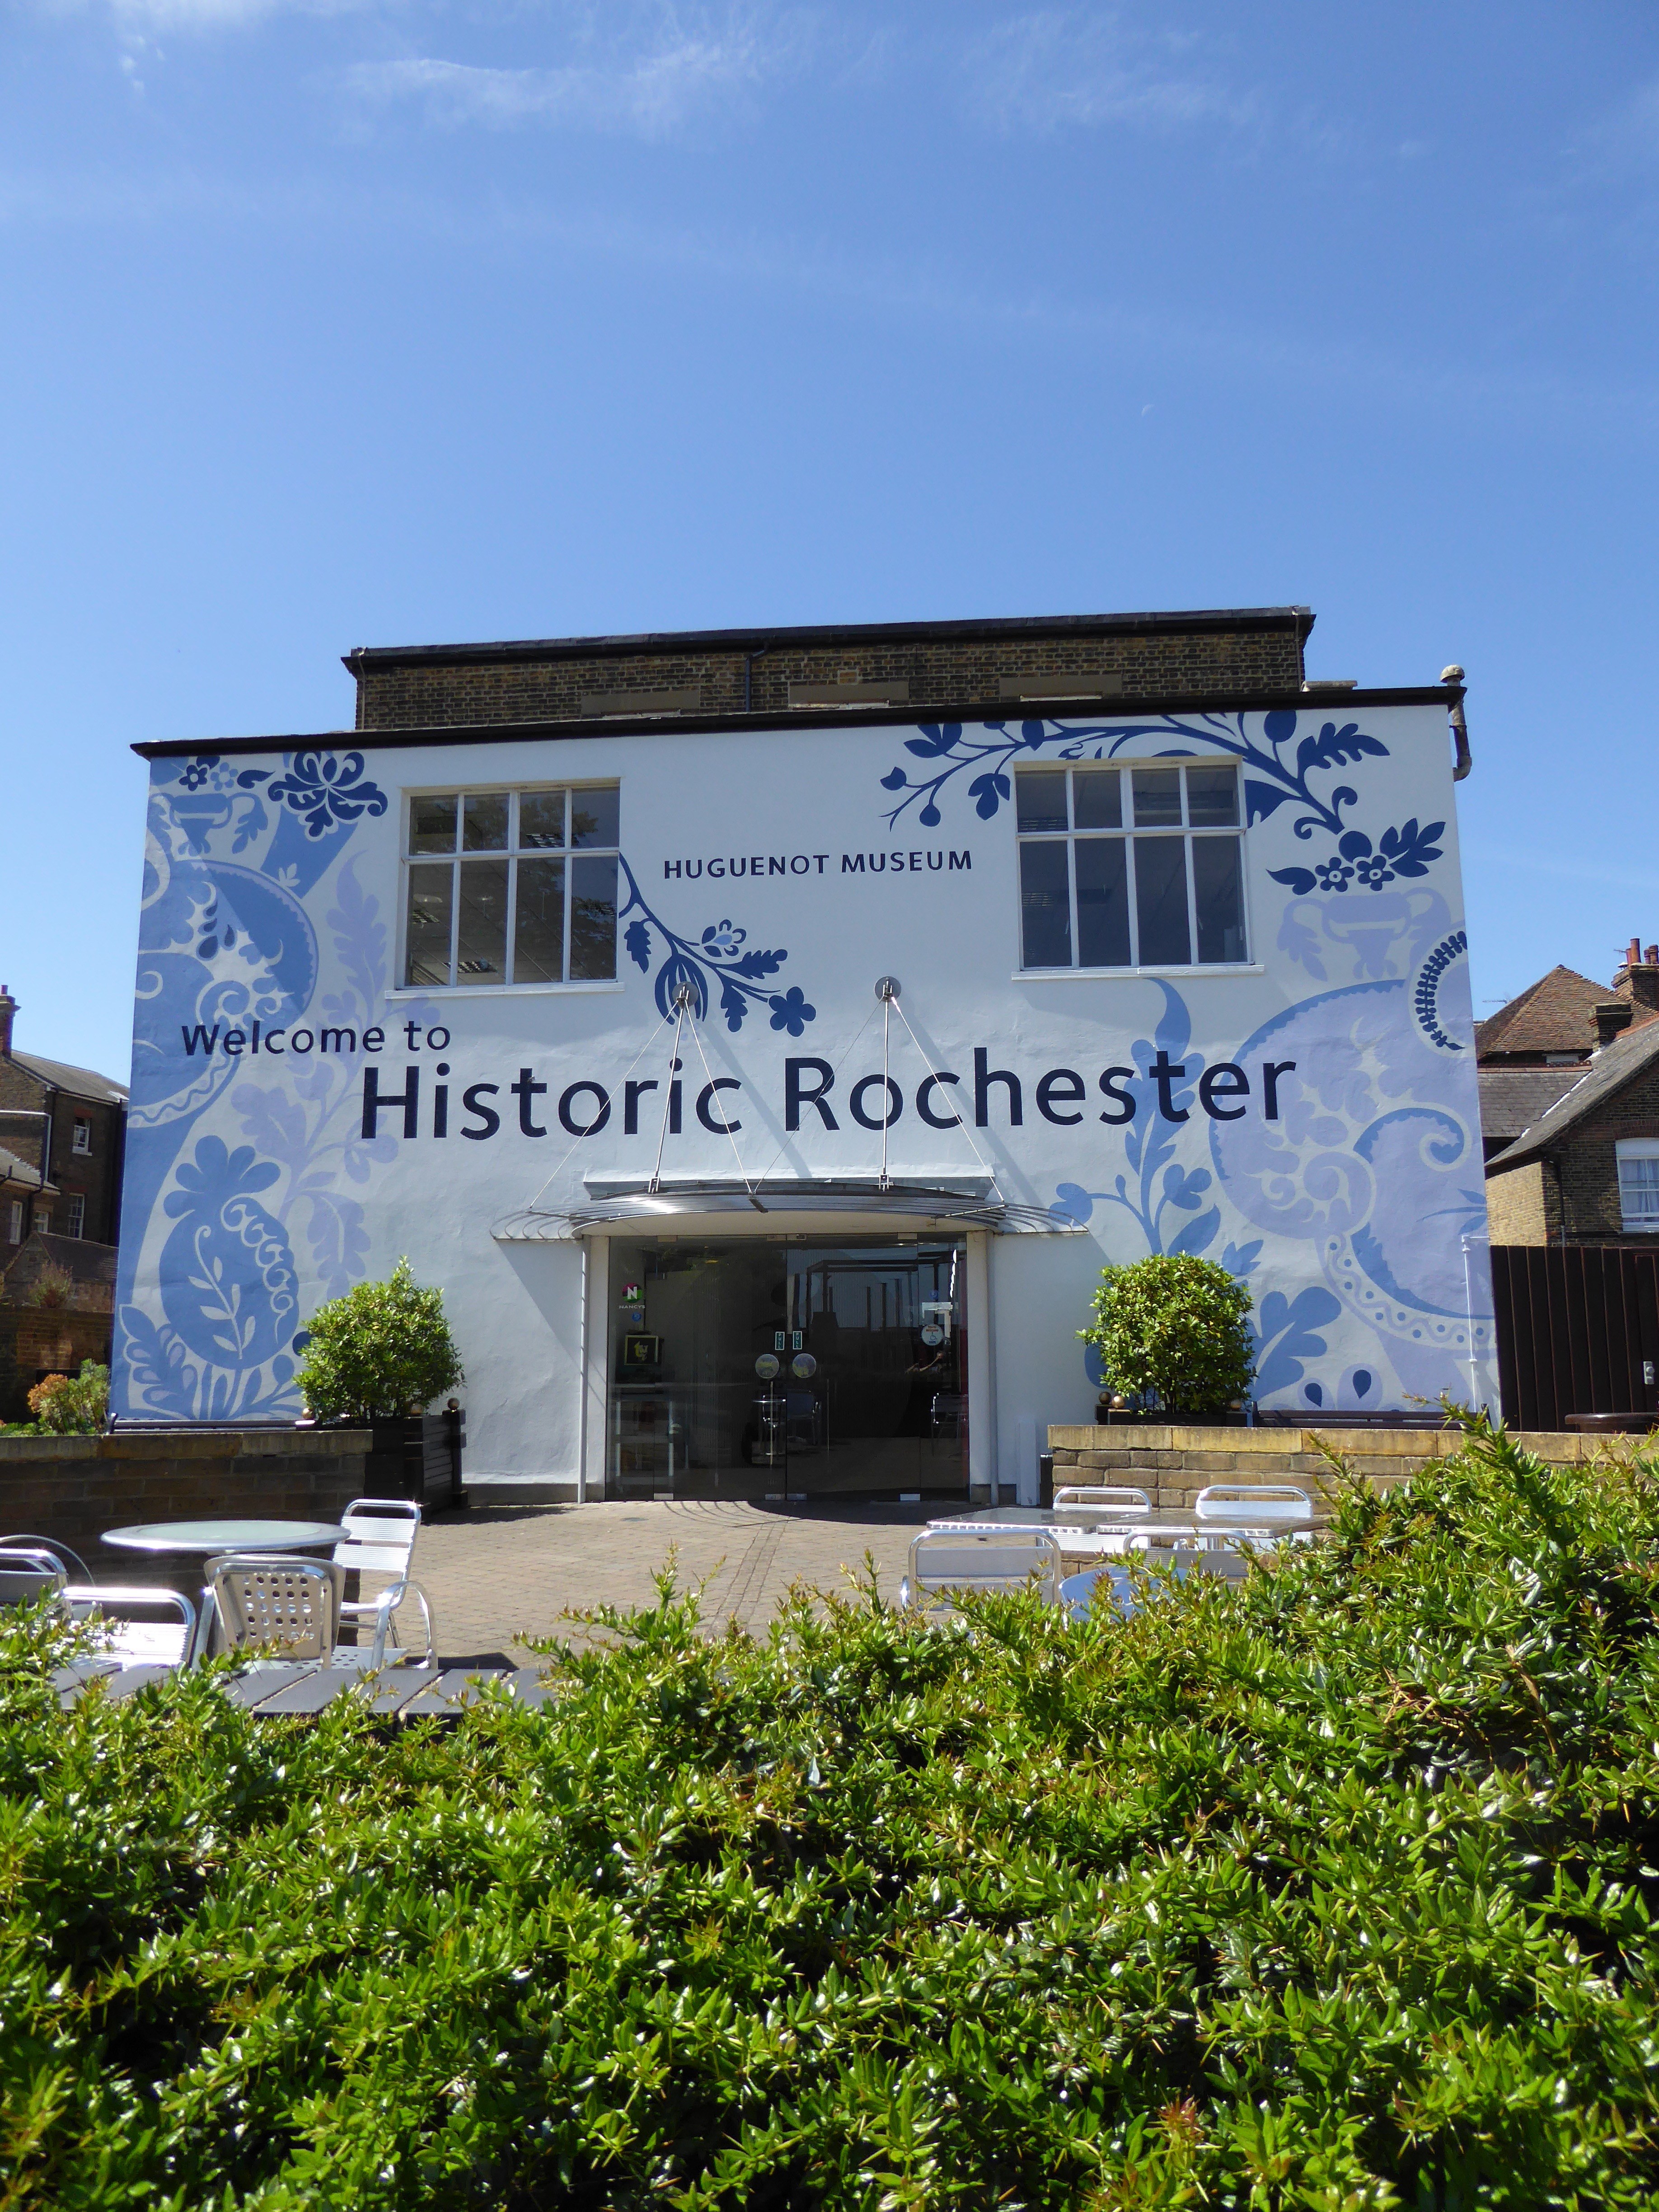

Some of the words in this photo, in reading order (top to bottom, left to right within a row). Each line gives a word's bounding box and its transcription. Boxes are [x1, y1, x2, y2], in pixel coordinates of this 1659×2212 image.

[664, 855, 830, 879] HUGUENOT
[841, 850, 972, 873] MUSEUM
[182, 1020, 384, 1056] Welcome
[403, 1020, 451, 1051] to
[361, 1057, 743, 1141] Historic
[785, 1046, 1297, 1132] Rochester
[627, 1286, 637, 1299] N
